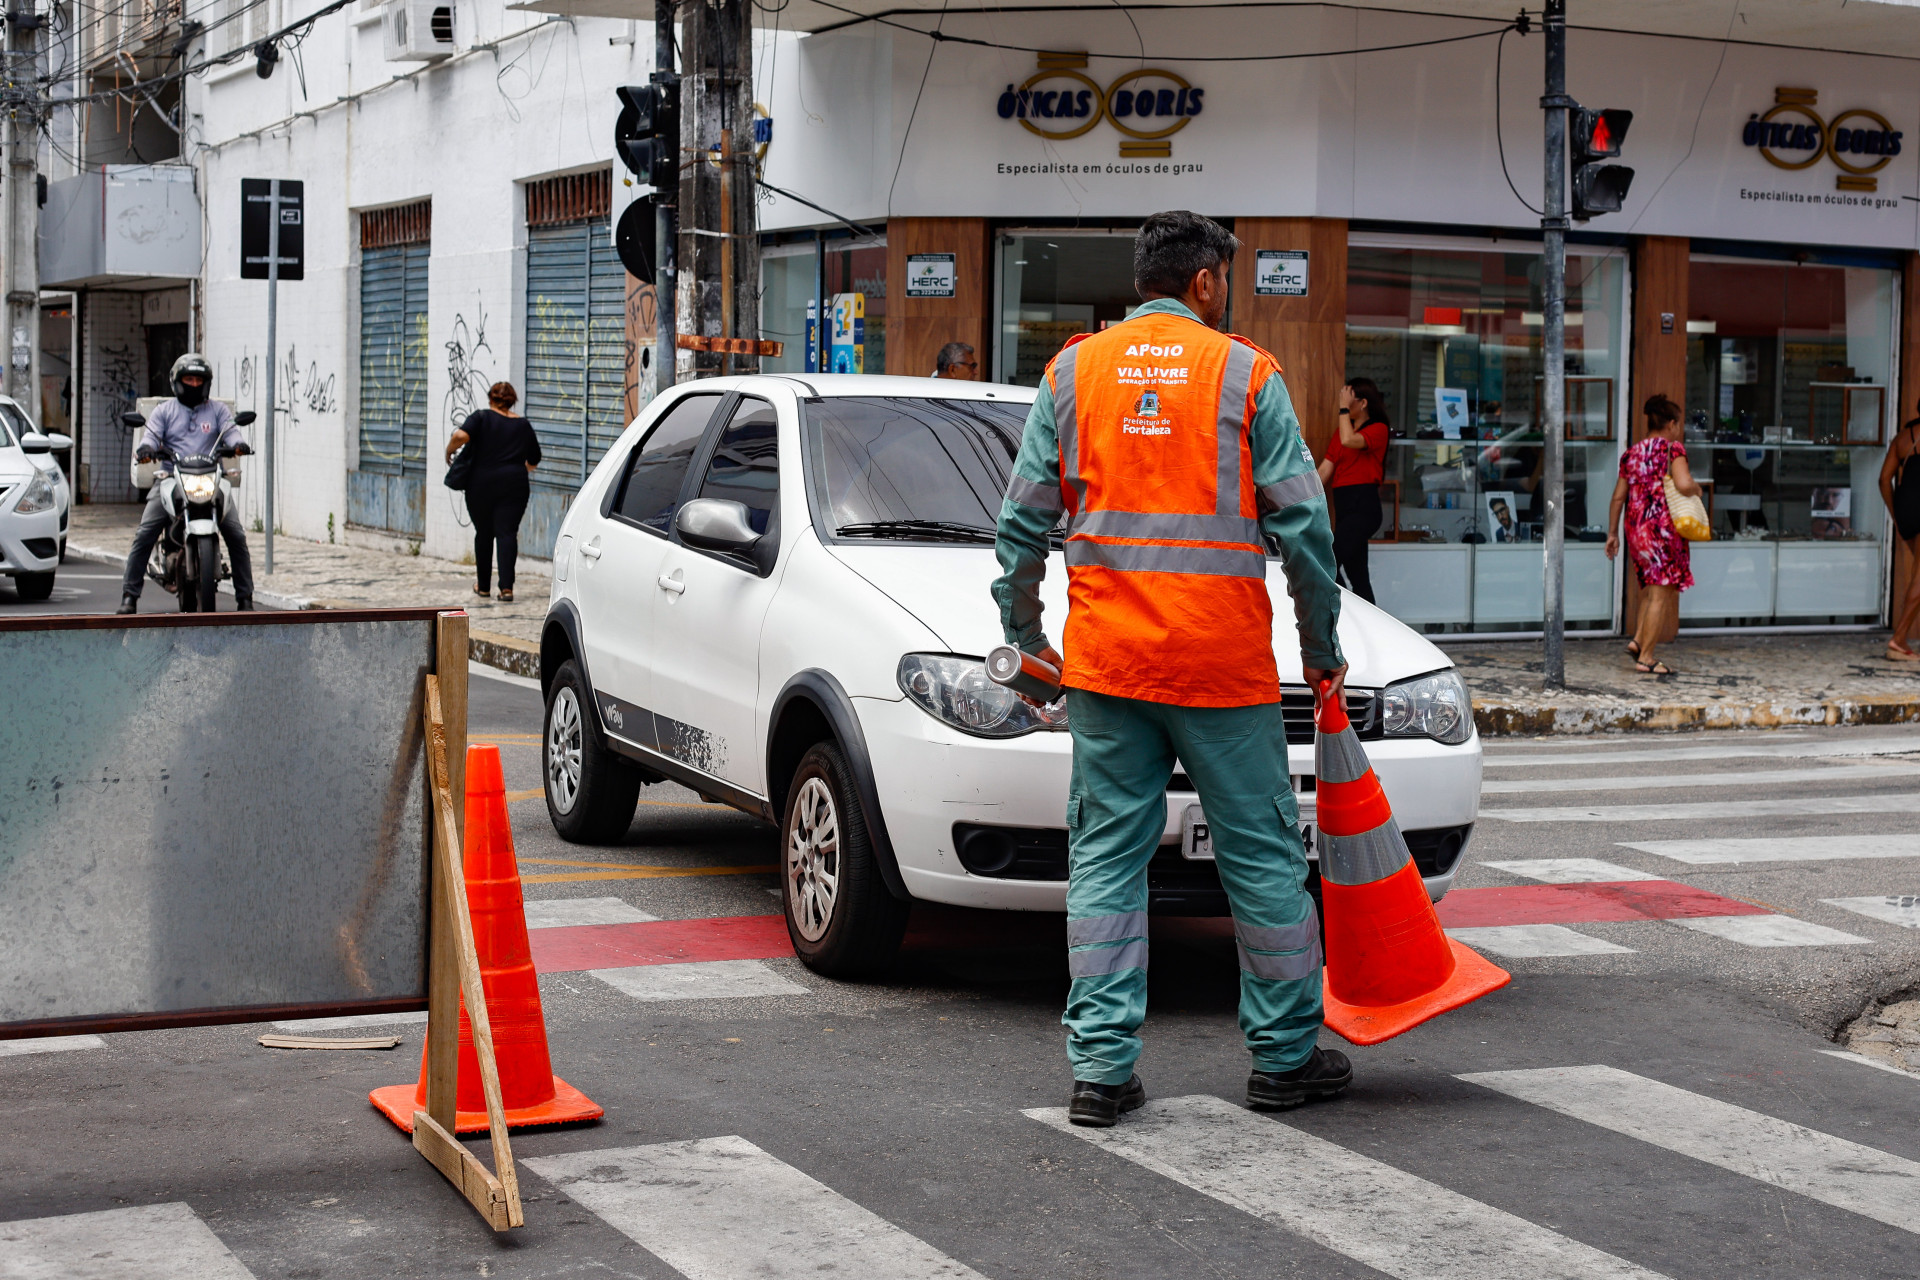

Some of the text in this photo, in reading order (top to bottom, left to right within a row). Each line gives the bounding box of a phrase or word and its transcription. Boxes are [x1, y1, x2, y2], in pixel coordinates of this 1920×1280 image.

[997, 84, 1204, 118] ÓTICAS BORIS
[1743, 114, 1903, 155] ÓTICAS BORIS
[997, 162, 1203, 175] Especialista em óculos de grau
[1740, 188, 1898, 209] Especialista em óculos de grau
[912, 277, 949, 287] HERC
[1261, 274, 1302, 285] HERC
[1125, 343, 1184, 357] APOIO
[1117, 366, 1189, 378] VIA LIVRE
[1117, 378, 1150, 386] OPERAÇÃO
[1123, 417, 1160, 426] Prefeitura
[1123, 424, 1171, 436] Fortaleza
[604, 703, 624, 730] Way
